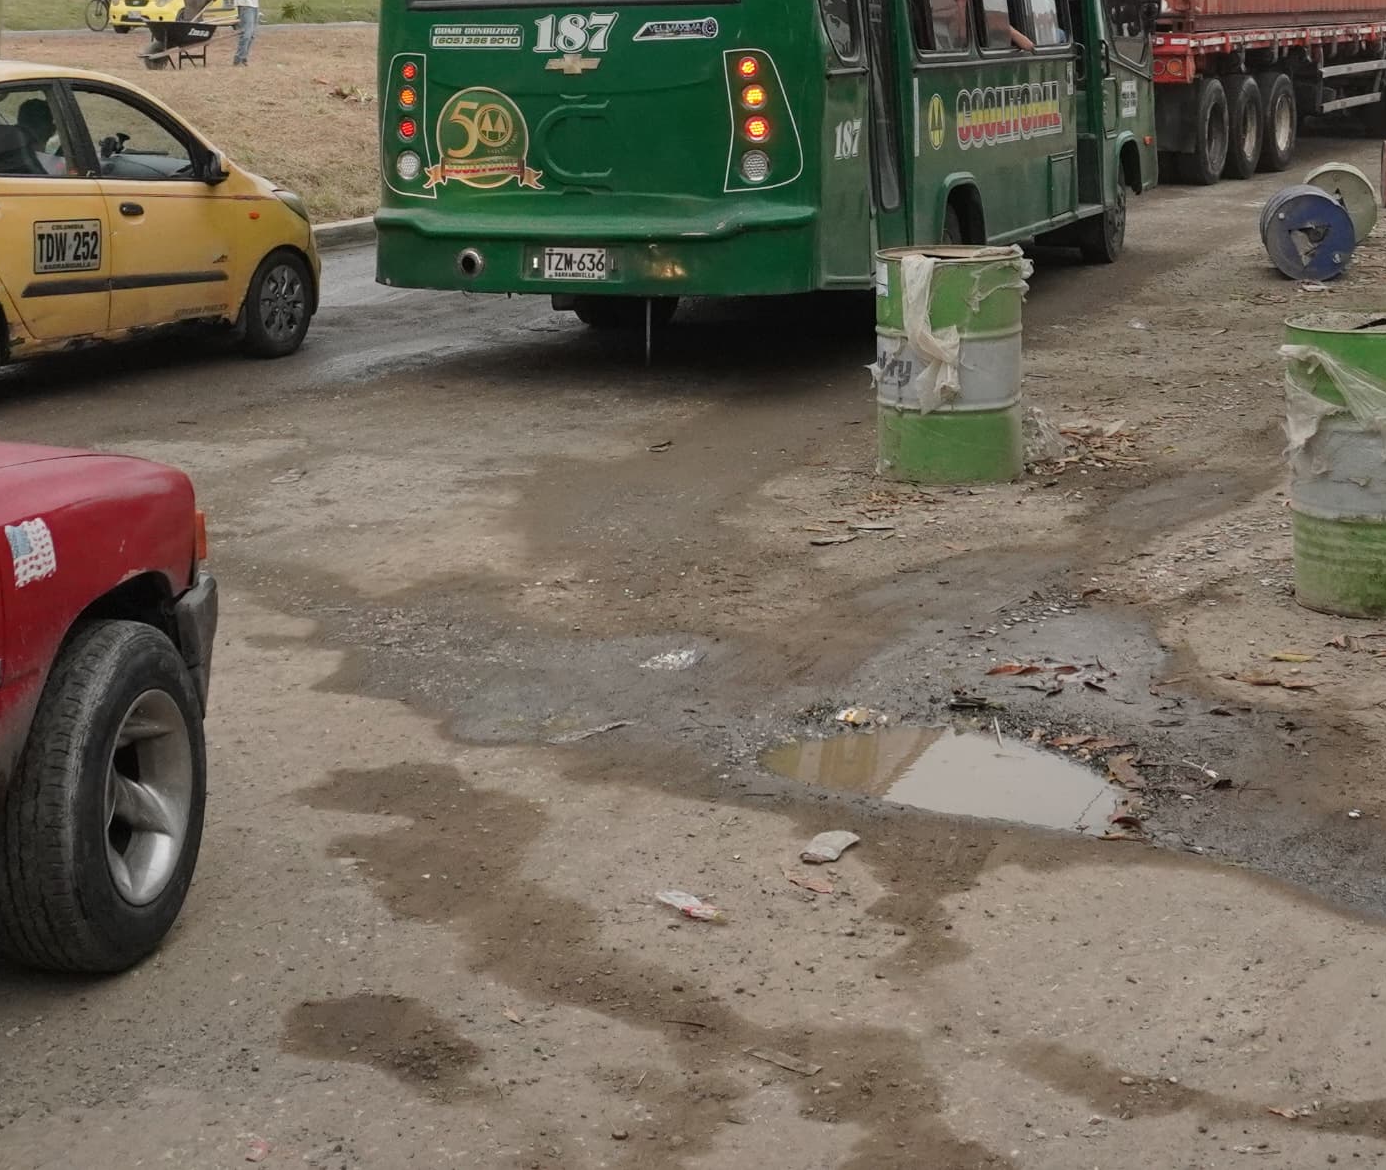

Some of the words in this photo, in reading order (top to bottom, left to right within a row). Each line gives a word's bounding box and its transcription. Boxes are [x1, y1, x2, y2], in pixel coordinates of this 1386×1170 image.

[464, 37, 488, 45] 386
[489, 37, 519, 45] 9010
[533, 12, 619, 54] 187
[956, 79, 1063, 151] COOLITORAL
[834, 117, 862, 161] 187
